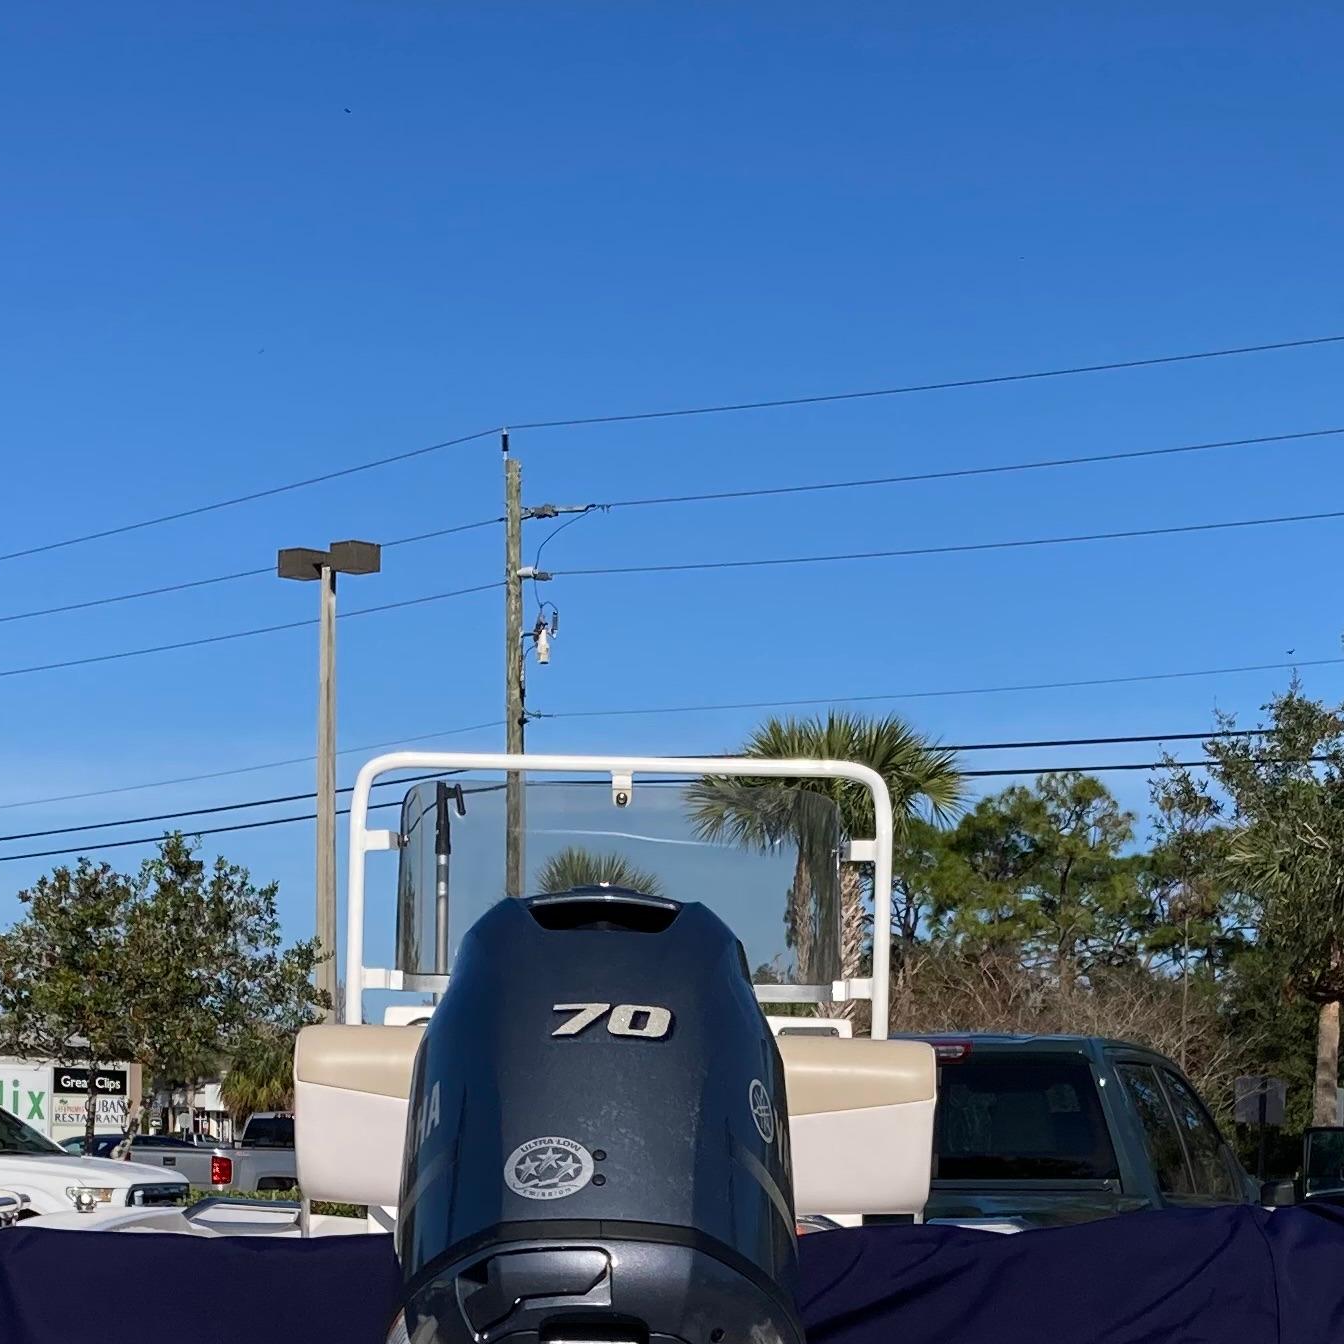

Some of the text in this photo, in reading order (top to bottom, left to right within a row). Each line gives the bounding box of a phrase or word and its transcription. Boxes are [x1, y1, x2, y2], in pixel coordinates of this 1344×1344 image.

[551, 1003, 671, 1037] 70
[60, 1076, 121, 1091] Grea Clips
[54, 1113, 125, 1123] RESTARANT
[520, 1138, 582, 1152] ULTRA LOW
